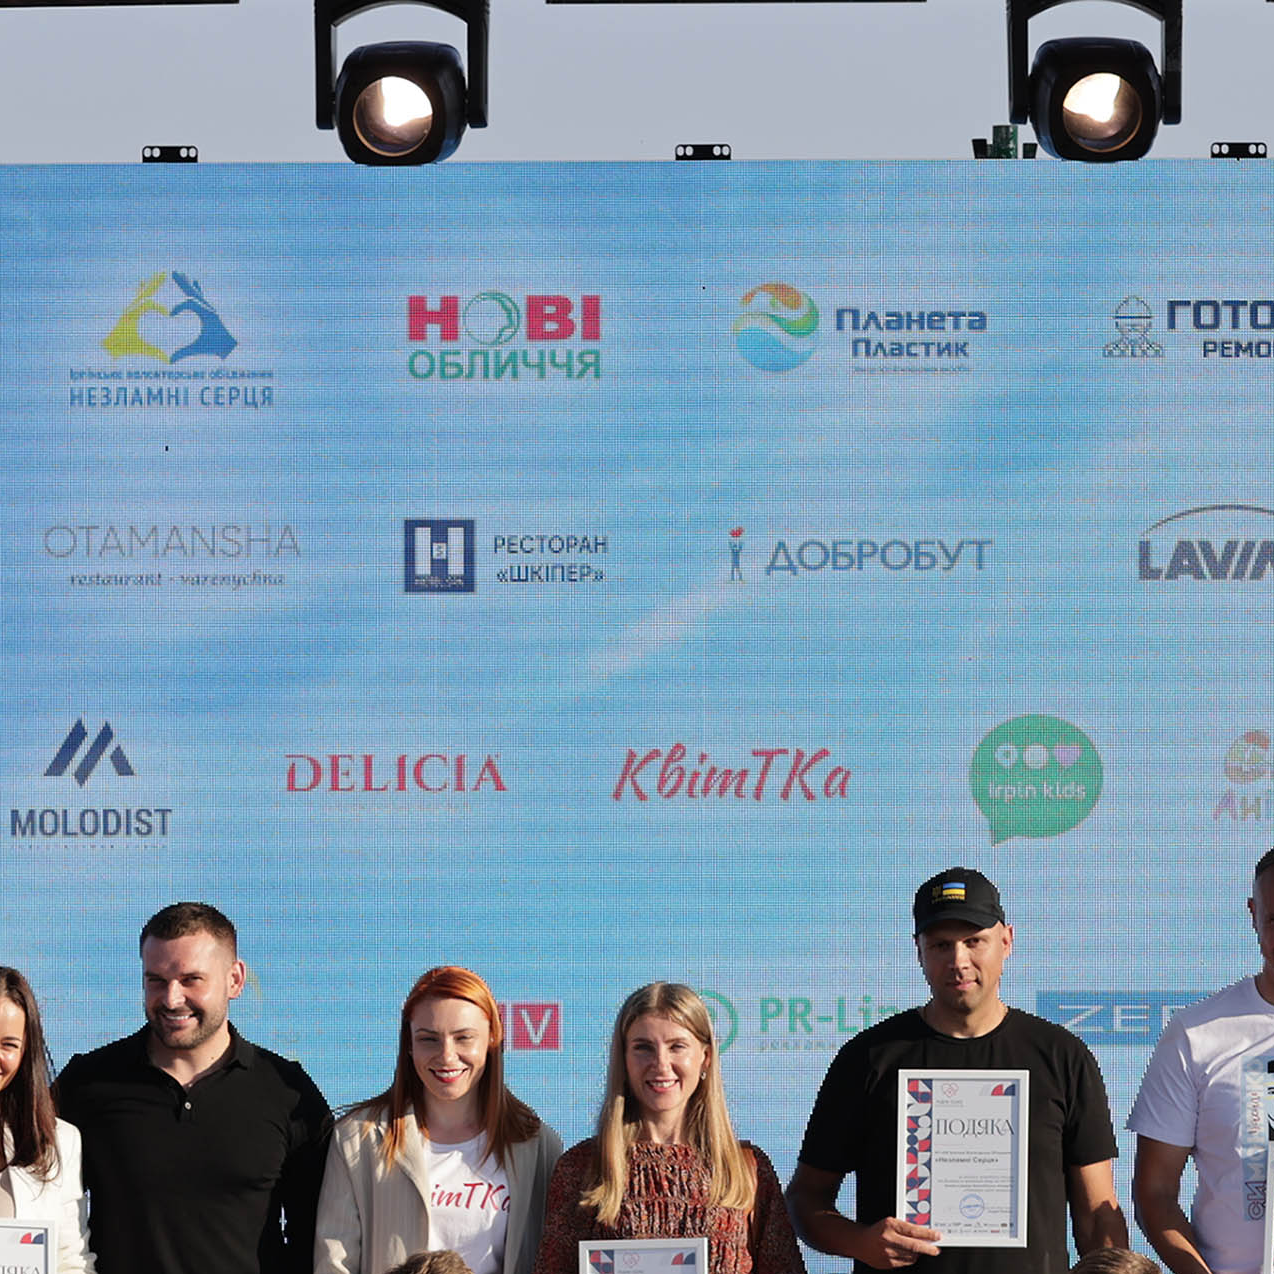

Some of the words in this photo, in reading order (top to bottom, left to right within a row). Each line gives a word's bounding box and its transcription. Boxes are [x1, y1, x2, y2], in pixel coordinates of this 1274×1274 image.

[835, 308, 988, 332] Планета
[852, 337, 970, 357] Пластик
[407, 349, 602, 381] ОБЛИЧЧЯ
[69, 386, 190, 408] НЕЗЛАМНІ
[199, 386, 273, 410] СЕРЦЯ
[43, 525, 302, 559] OTAMANSHA
[493, 535, 609, 554] РЕСТОРАН
[765, 539, 993, 577] ДОБРОБУТ
[496, 564, 606, 583] «ШКІПЕР»
[284, 753, 509, 792] DELICIA
[10, 808, 173, 837] MOLODIST
[759, 995, 899, 1034] PR-Li
[935, 1117, 1015, 1139] ПОДЯКА
